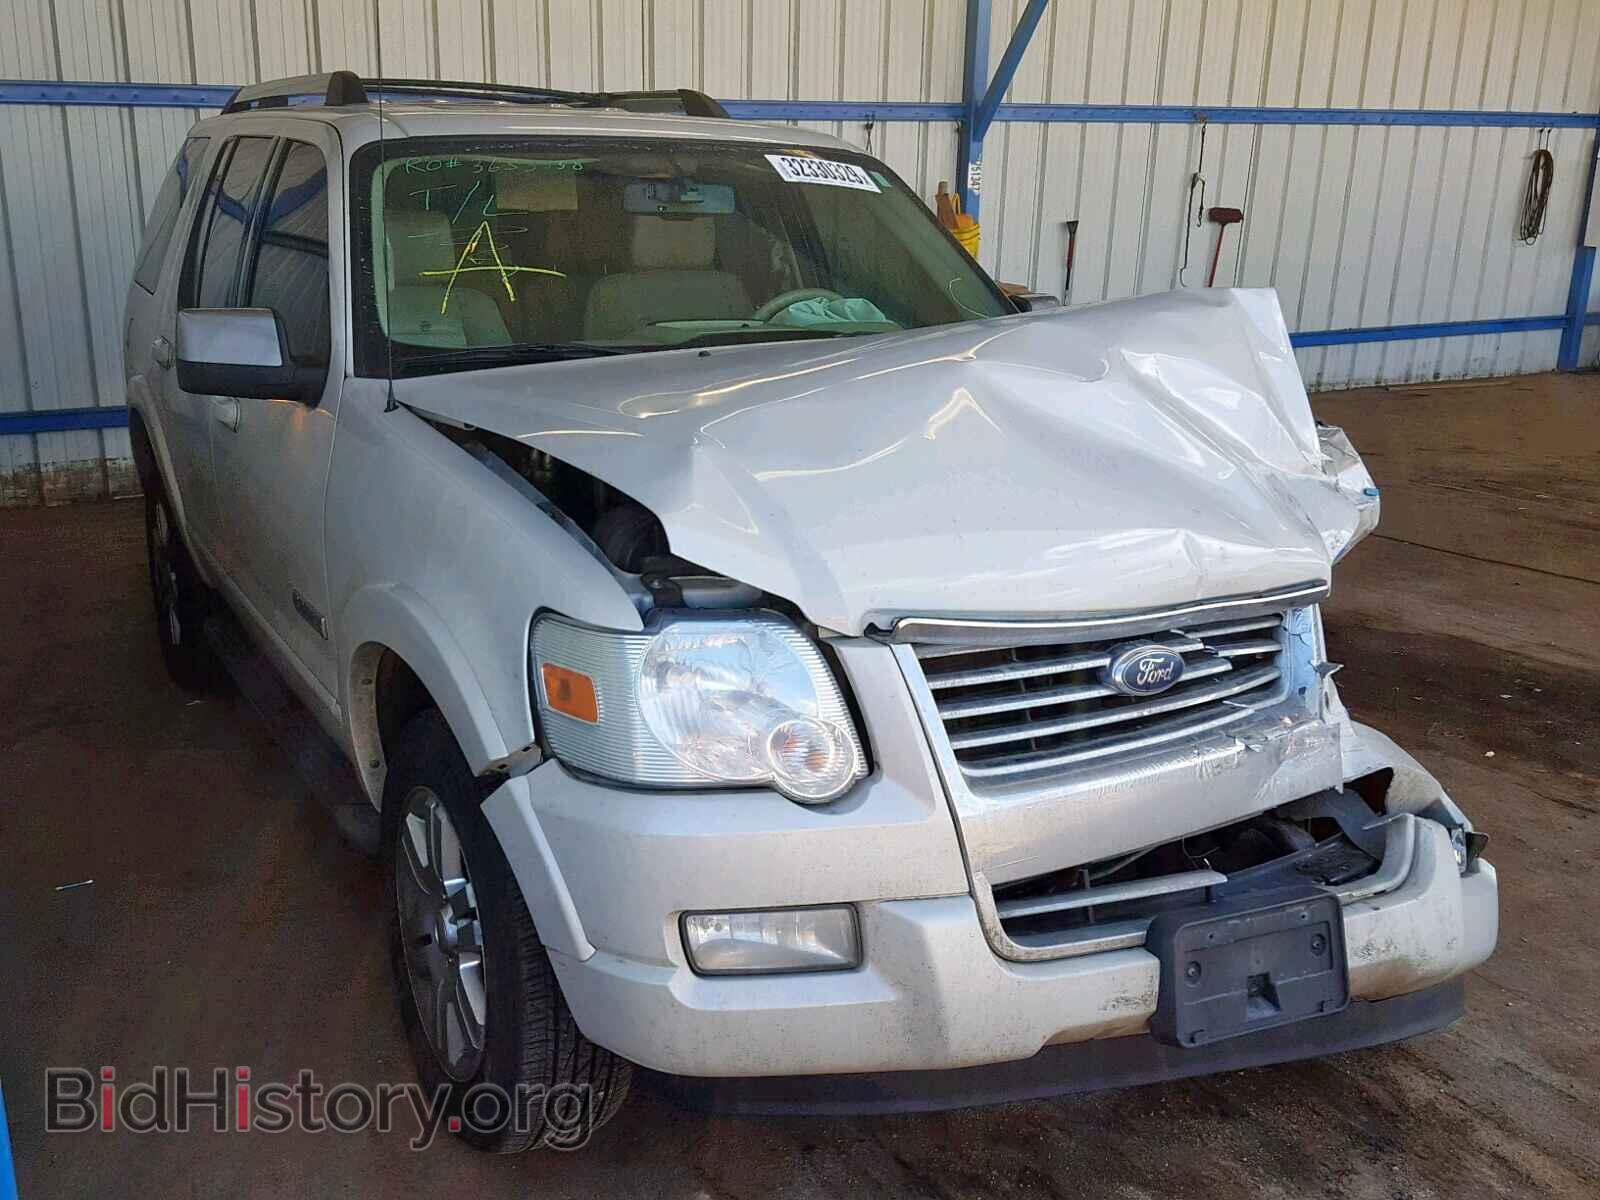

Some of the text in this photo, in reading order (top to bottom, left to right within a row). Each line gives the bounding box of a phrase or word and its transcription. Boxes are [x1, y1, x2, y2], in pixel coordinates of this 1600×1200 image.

[780, 156, 863, 184] 32330329
[418, 220, 568, 315] A
[1136, 657, 1174, 685] Ford
